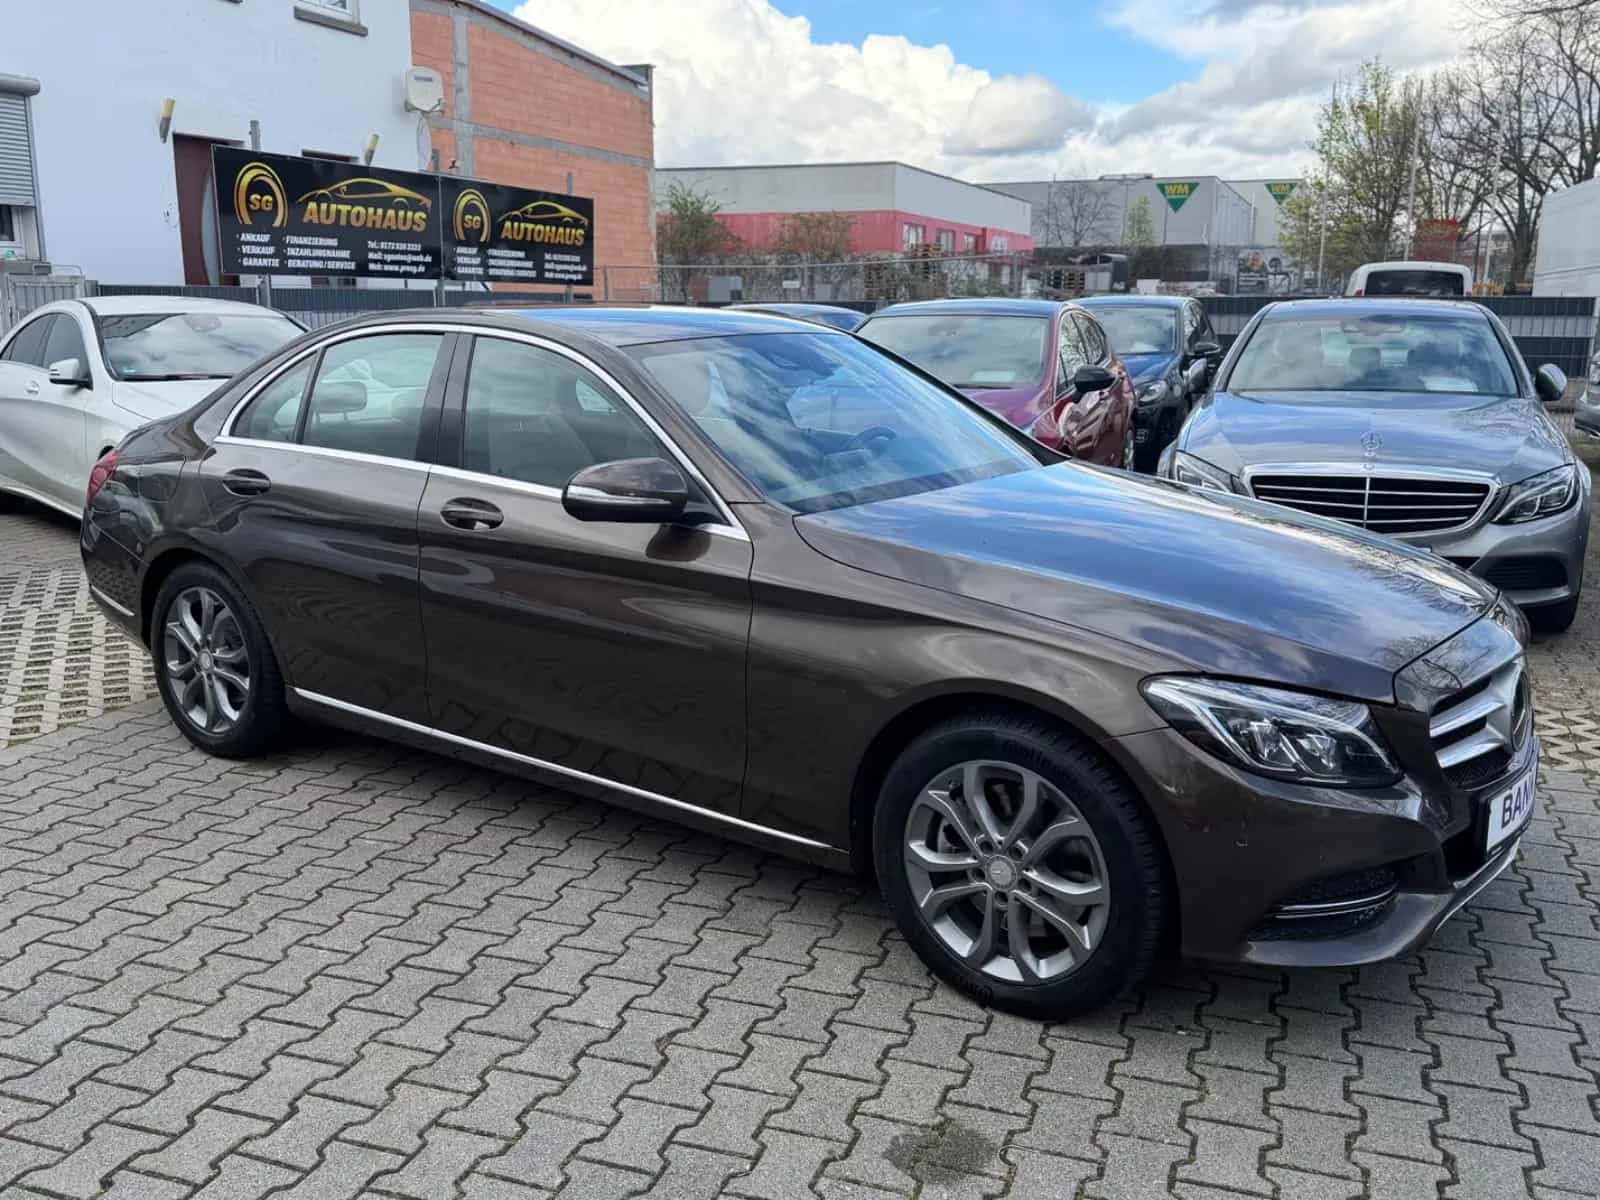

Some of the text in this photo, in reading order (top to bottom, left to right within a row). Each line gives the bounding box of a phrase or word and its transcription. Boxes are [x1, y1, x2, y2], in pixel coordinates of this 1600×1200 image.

[1165, 183, 1189, 194] WM
[1271, 183, 1289, 193] WM
[249, 194, 273, 211] SG
[303, 202, 428, 232] AUTOHAUS
[464, 215, 481, 229] SG
[240, 232, 271, 242] ANKAUF
[501, 221, 584, 246] AUTOHAUS
[286, 235, 338, 247] FINANZIERUNG
[241, 245, 275, 254] VERKAUF
[242, 257, 280, 267] GARANTIE
